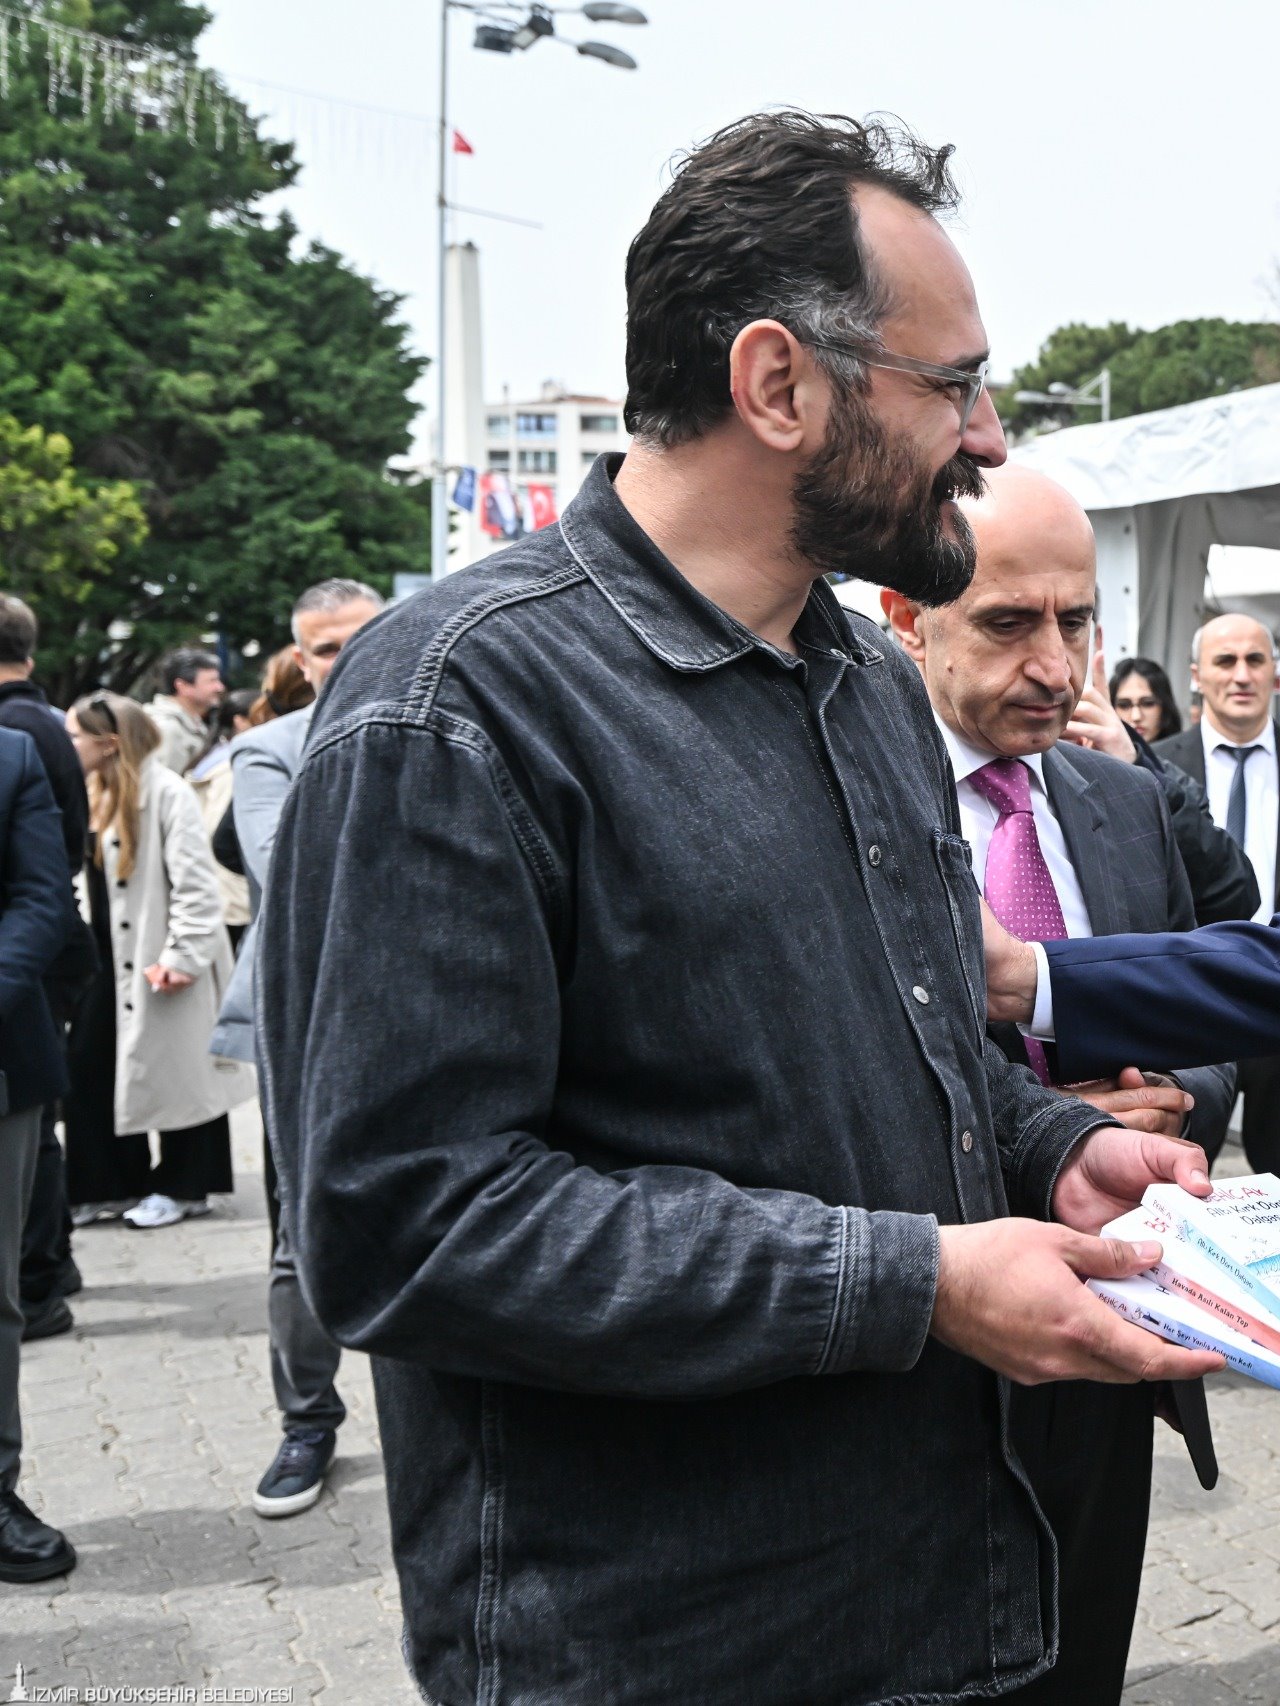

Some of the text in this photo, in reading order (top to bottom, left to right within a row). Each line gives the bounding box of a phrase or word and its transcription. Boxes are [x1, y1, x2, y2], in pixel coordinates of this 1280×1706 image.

[1171, 1278, 1197, 1298] Havada
[1214, 1302, 1234, 1320] Kalan
[1236, 1315, 1249, 1329] Top
